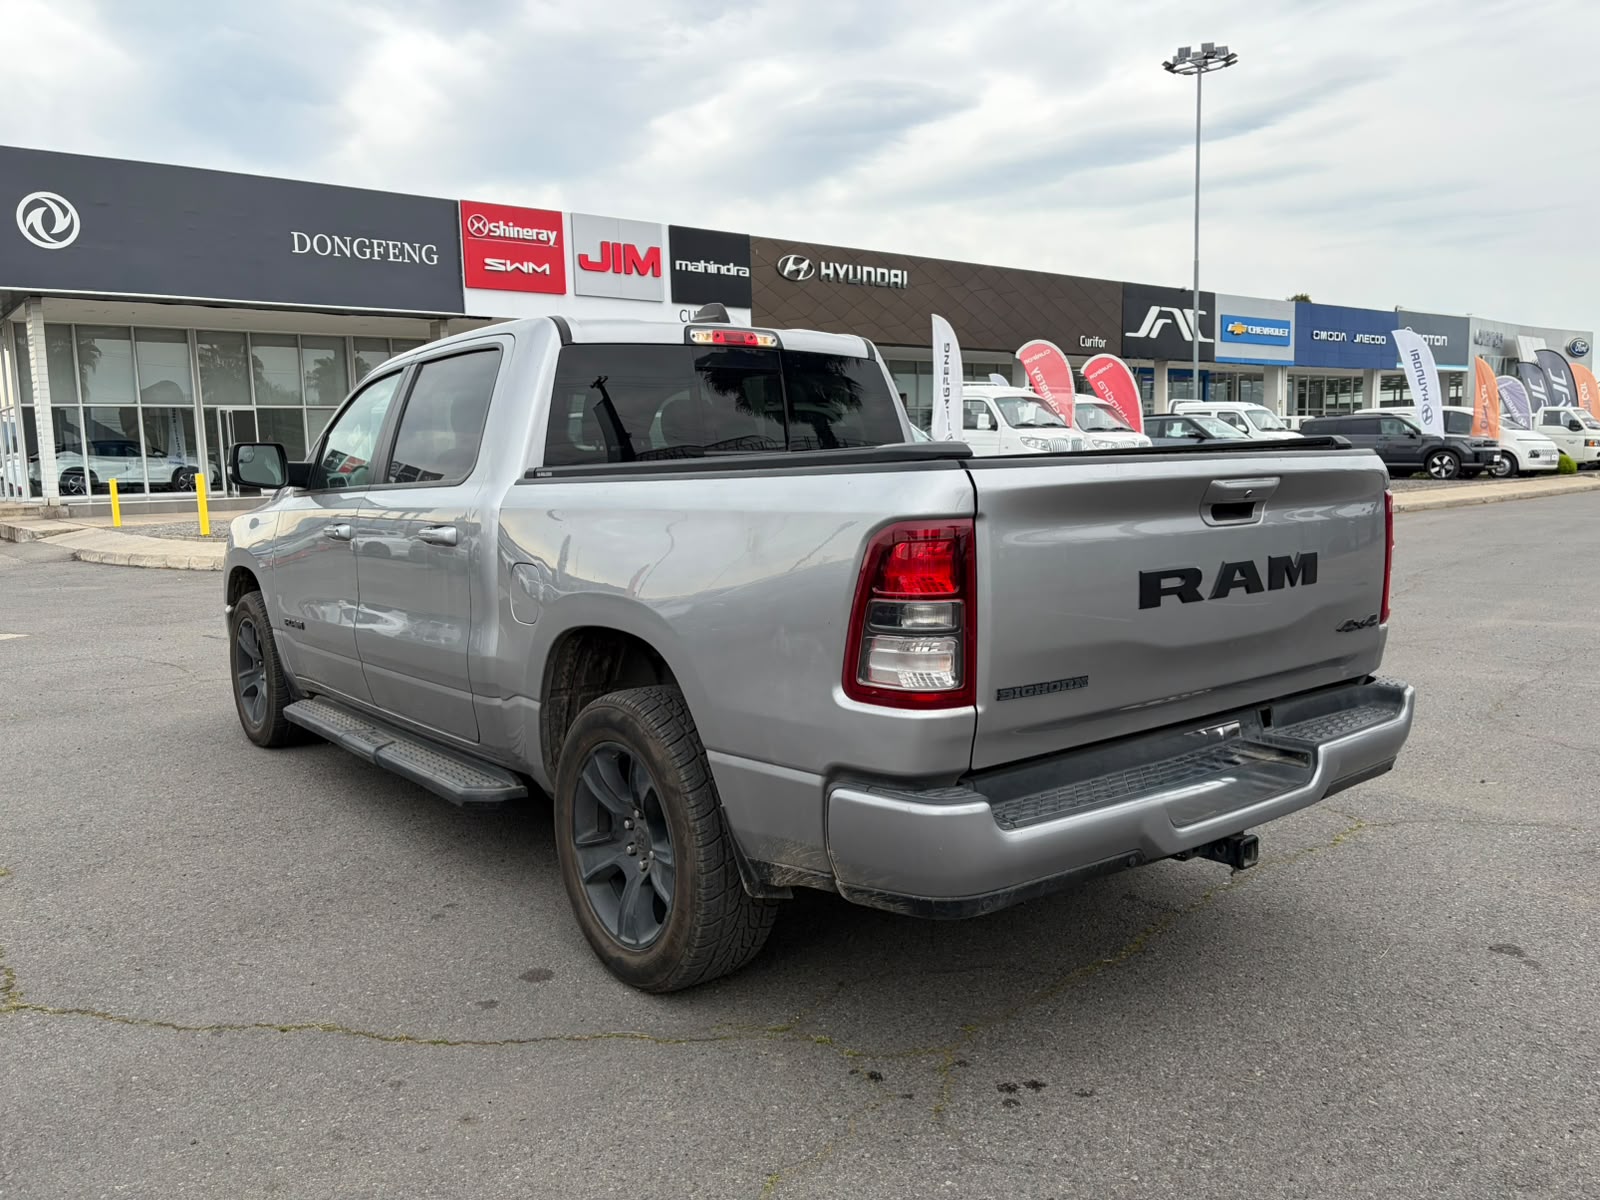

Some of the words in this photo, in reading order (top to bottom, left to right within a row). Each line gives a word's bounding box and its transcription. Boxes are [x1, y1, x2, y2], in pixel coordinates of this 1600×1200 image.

[291, 231, 438, 265] DONGFENG
[484, 257, 550, 275] SWM
[578, 241, 662, 277] JIM
[675, 260, 750, 277] mahindra
[820, 261, 909, 288] HYUNDAI
[1247, 325, 1289, 337] CHEVROLET
[1312, 330, 1347, 342] OMODA
[1419, 334, 1448, 346] OTON
[1080, 335, 1107, 348] Curifor
[1138, 552, 1318, 609] RAM
[1336, 613, 1378, 632] 4x4
